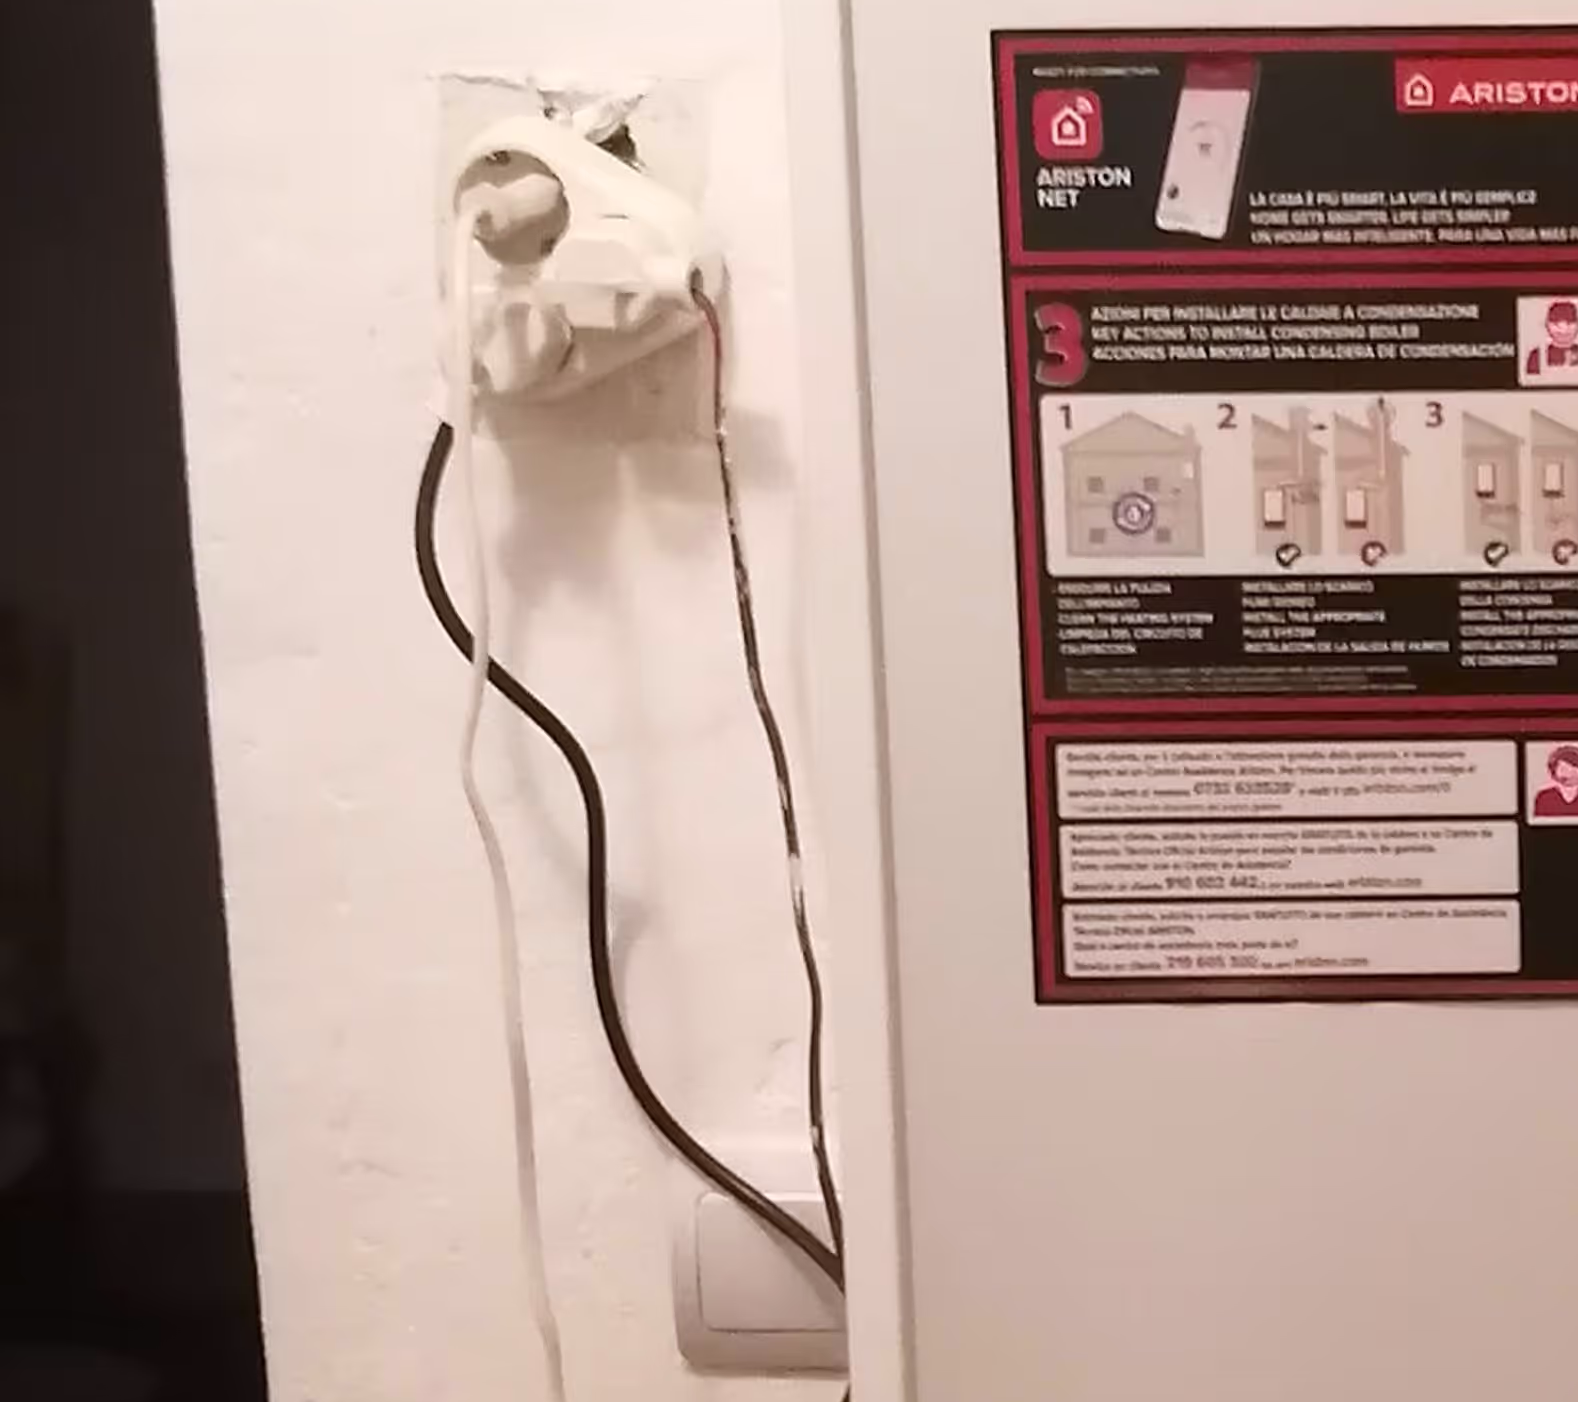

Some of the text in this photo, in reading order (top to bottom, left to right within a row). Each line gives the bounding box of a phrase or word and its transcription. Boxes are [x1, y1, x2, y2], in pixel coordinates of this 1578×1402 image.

[1036, 165, 1132, 187] ARISTON
[1036, 188, 1081, 208] NET
[1035, 302, 1087, 388] 3
[1059, 405, 1074, 430] 1
[1217, 404, 1237, 430] 2
[1425, 404, 1444, 429] 3
